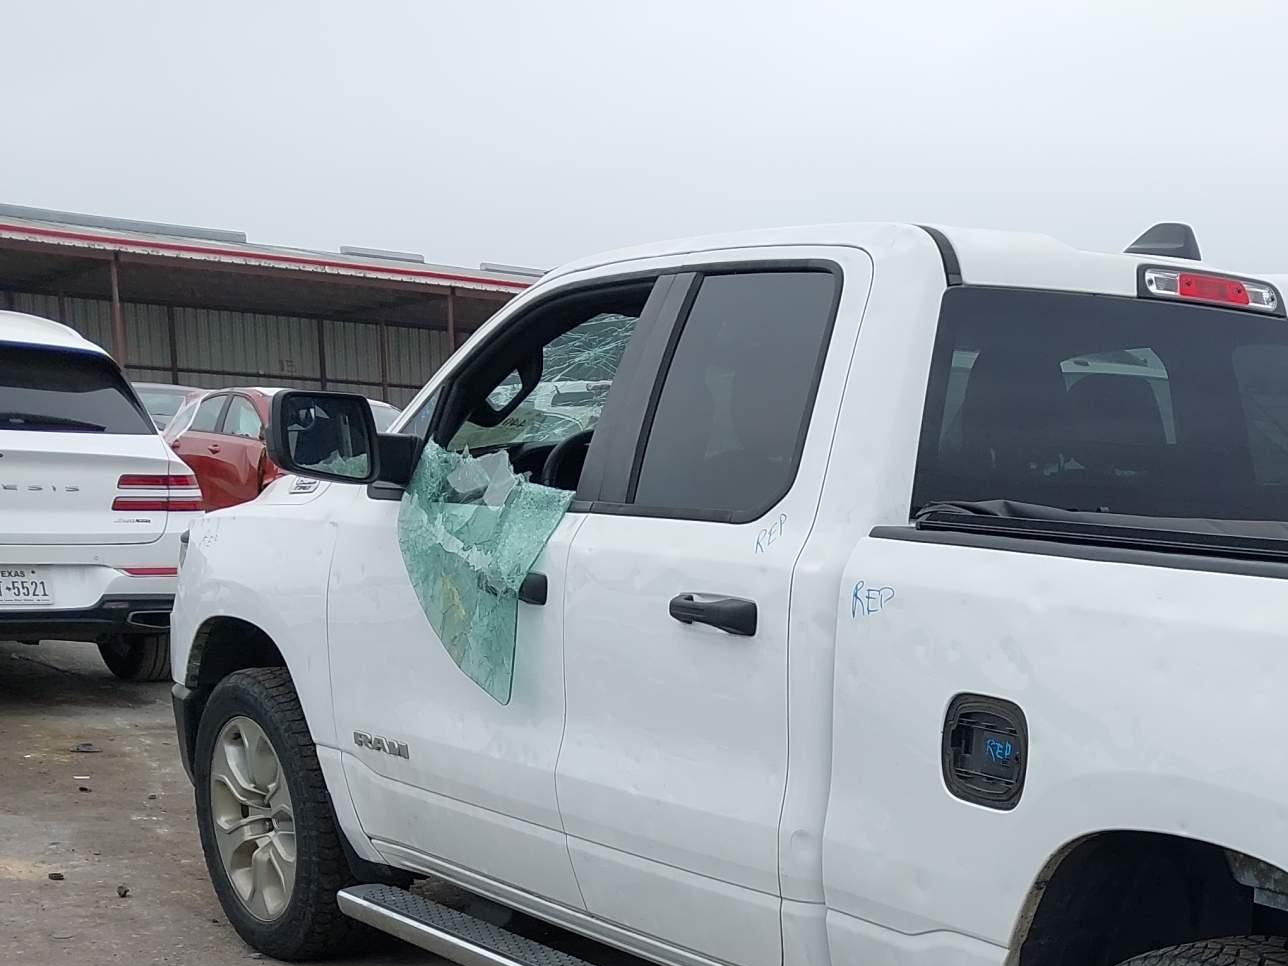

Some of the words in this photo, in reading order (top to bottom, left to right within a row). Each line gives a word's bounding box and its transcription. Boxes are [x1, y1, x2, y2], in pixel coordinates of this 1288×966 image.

[1, 484, 80, 492] ESIS
[755, 513, 787, 554] REP
[1, 570, 25, 578] EXAS
[852, 580, 894, 619] REP
[353, 731, 409, 760] RAM
[986, 739, 1012, 762] REP
